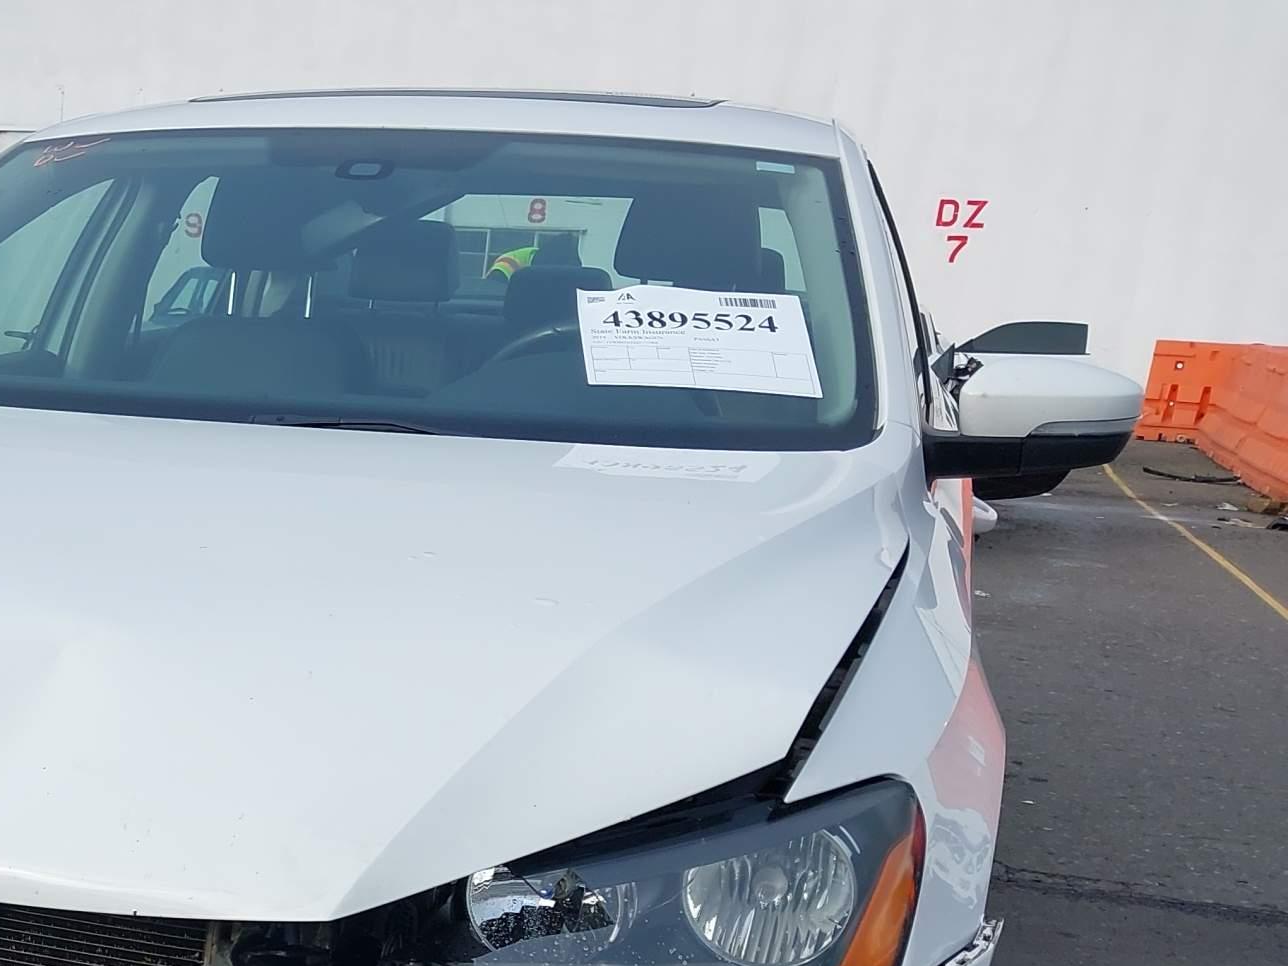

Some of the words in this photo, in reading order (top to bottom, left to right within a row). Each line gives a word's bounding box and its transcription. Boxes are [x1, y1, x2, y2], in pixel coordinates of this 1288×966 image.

[527, 197, 547, 224] 8
[935, 198, 990, 229] DZ
[946, 235, 969, 264] 7
[602, 310, 779, 333] 43895524
